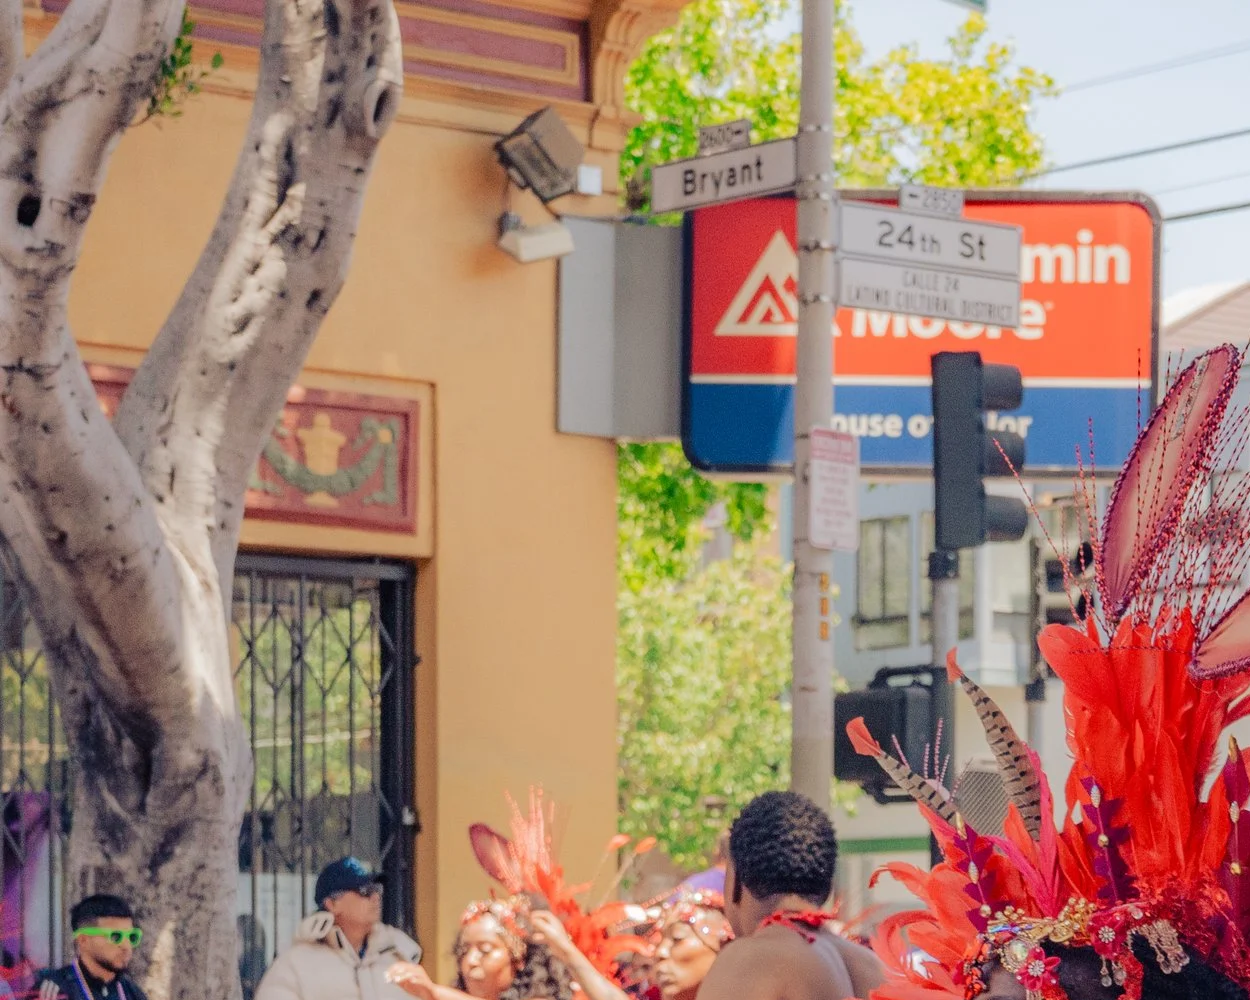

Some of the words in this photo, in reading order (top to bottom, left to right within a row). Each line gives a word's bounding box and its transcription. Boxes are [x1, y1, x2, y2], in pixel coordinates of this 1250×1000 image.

[683, 156, 764, 197] Bryant
[877, 220, 941, 254] 24th
[959, 232, 987, 261] St
[907, 414, 935, 438] o
[986, 412, 1033, 437] lor
